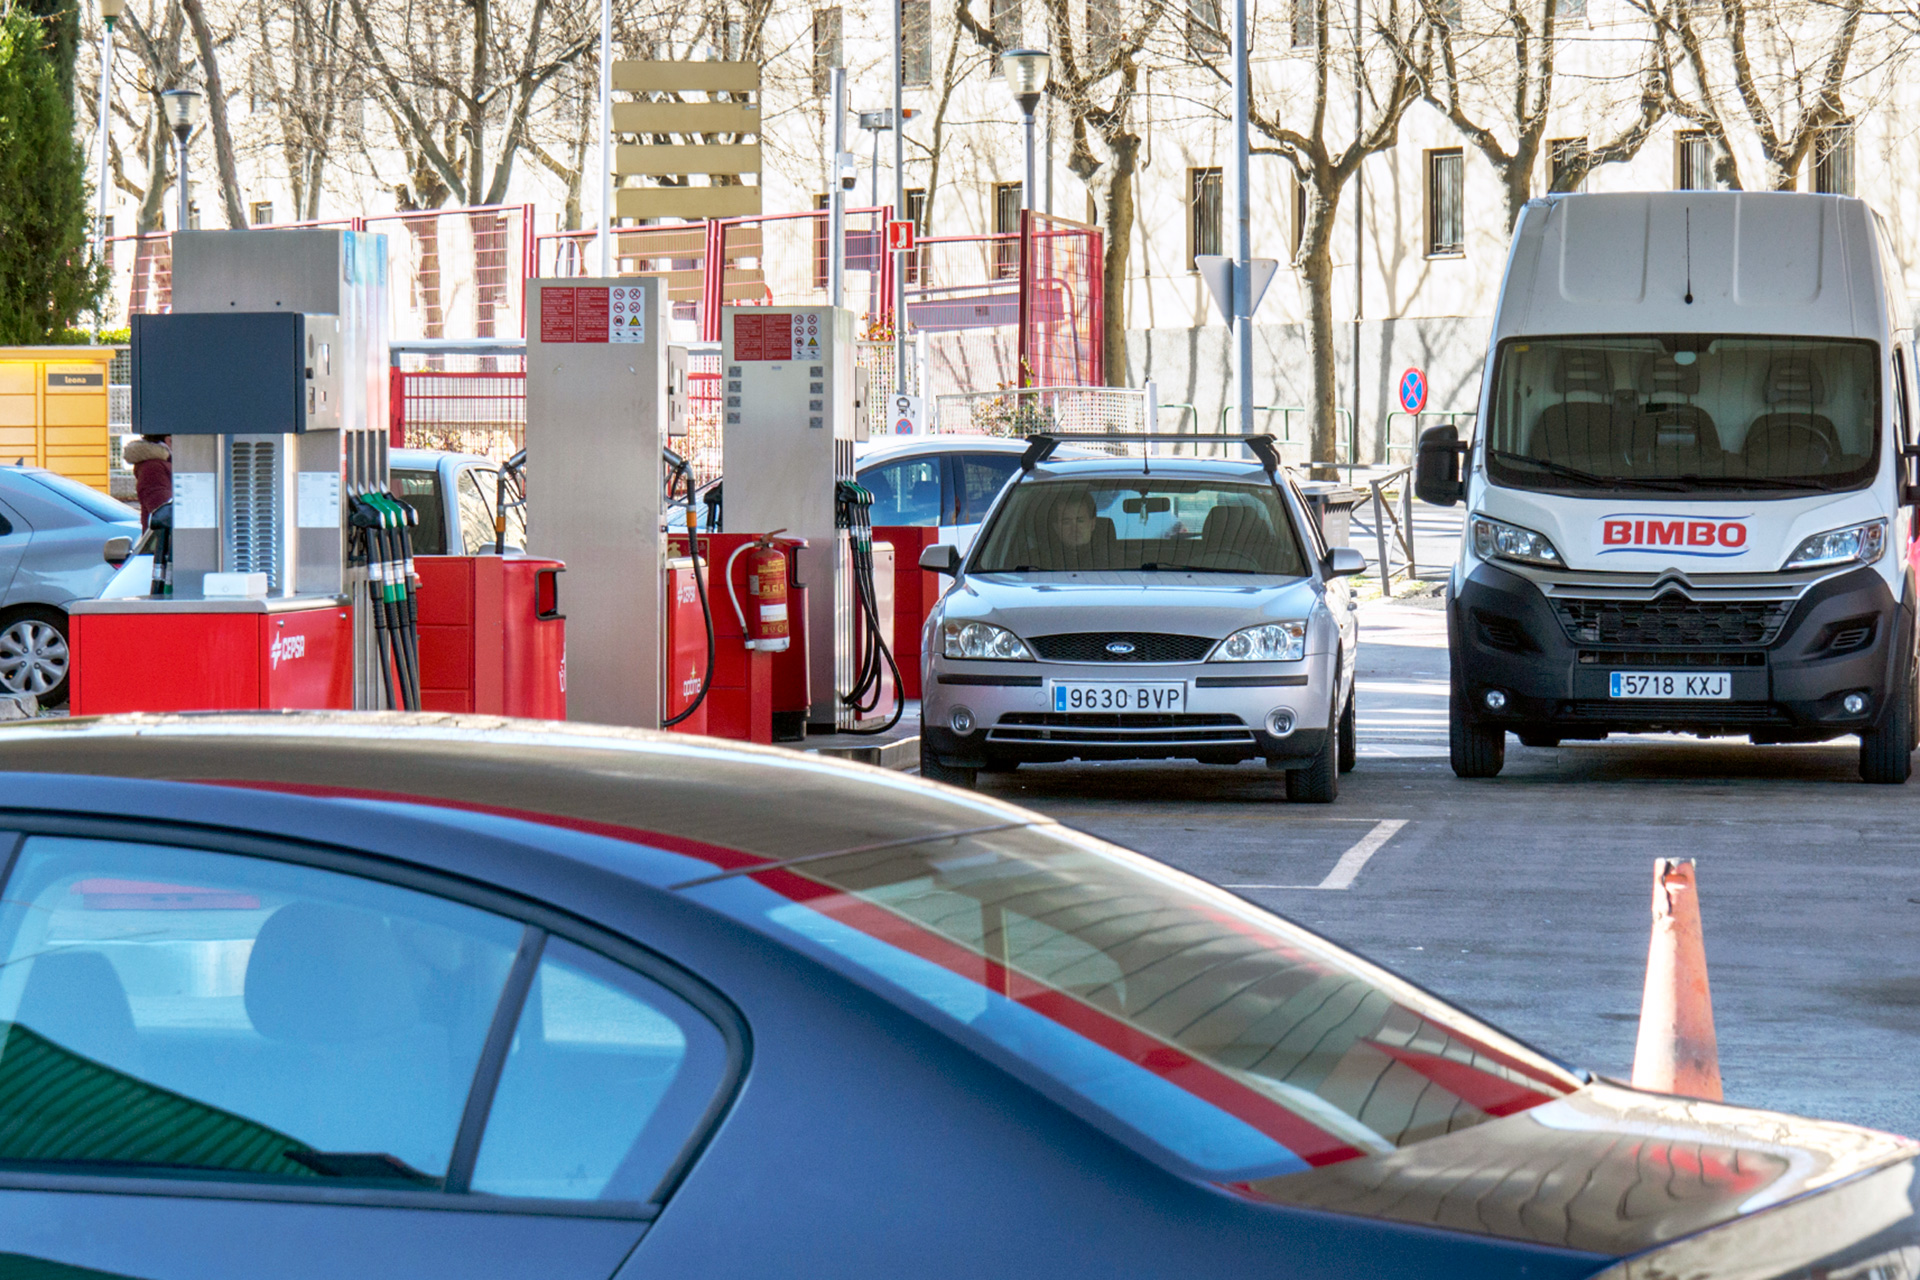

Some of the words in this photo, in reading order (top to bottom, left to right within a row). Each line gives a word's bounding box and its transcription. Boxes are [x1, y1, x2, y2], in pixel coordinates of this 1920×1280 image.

[1603, 520, 1747, 548] BIMBO
[282, 635, 305, 661] CEPSA
[1626, 675, 1674, 695] 5718
[1686, 676, 1723, 696] KXJ
[1070, 688, 1128, 709] 9630
[1137, 688, 1180, 709] BVP
